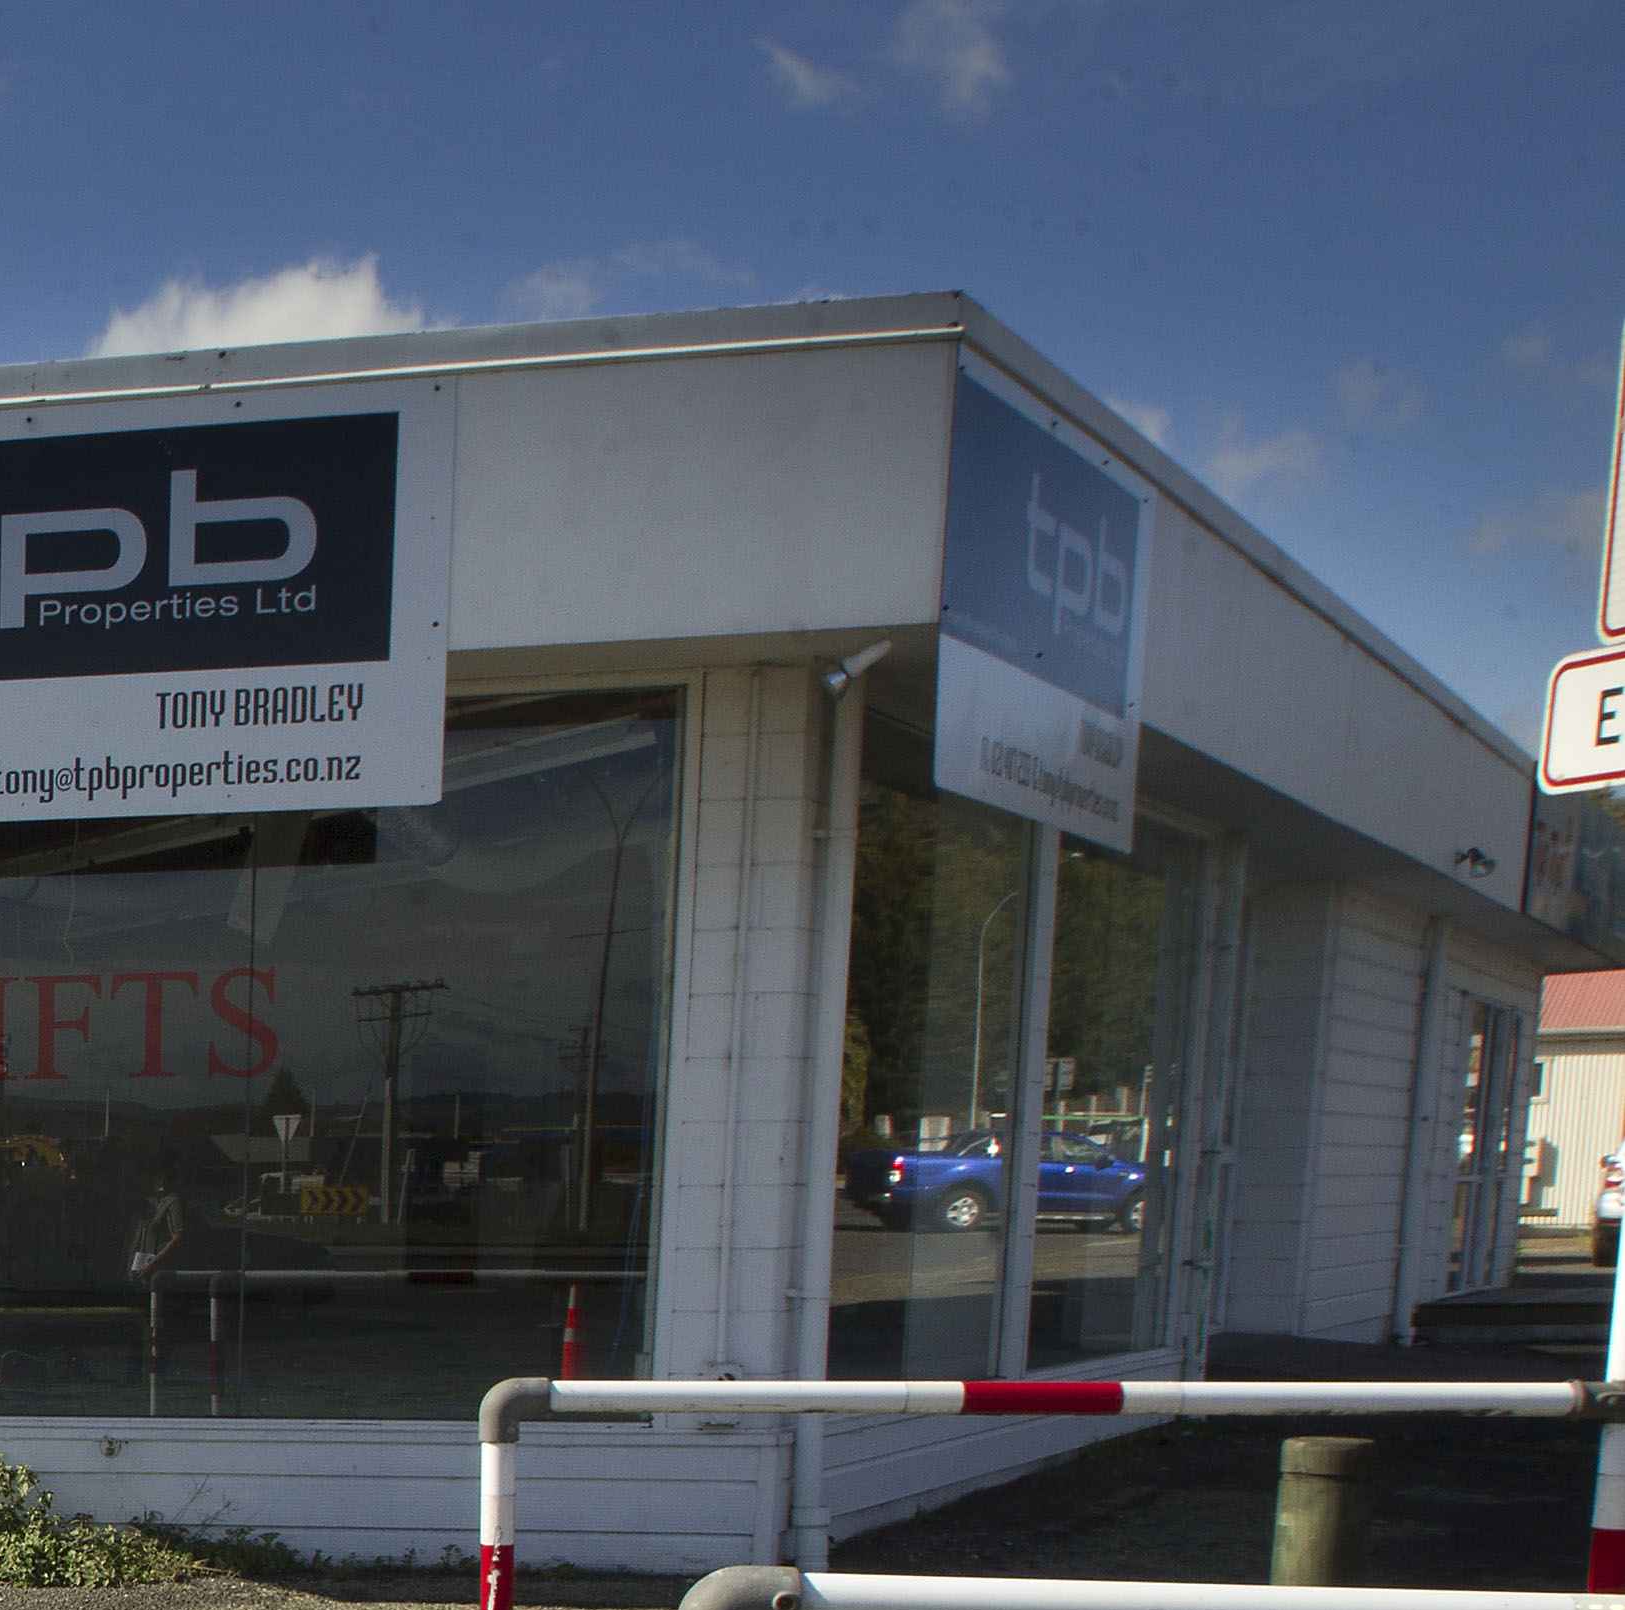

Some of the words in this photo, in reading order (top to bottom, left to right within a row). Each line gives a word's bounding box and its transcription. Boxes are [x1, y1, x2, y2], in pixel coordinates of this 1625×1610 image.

[1027, 470, 1127, 636] tpb
[38, 592, 240, 630] Properties
[255, 585, 317, 616] Ltd
[155, 690, 225, 730] TONY
[233, 684, 364, 727] BRADLEY
[1595, 686, 1625, 748] E
